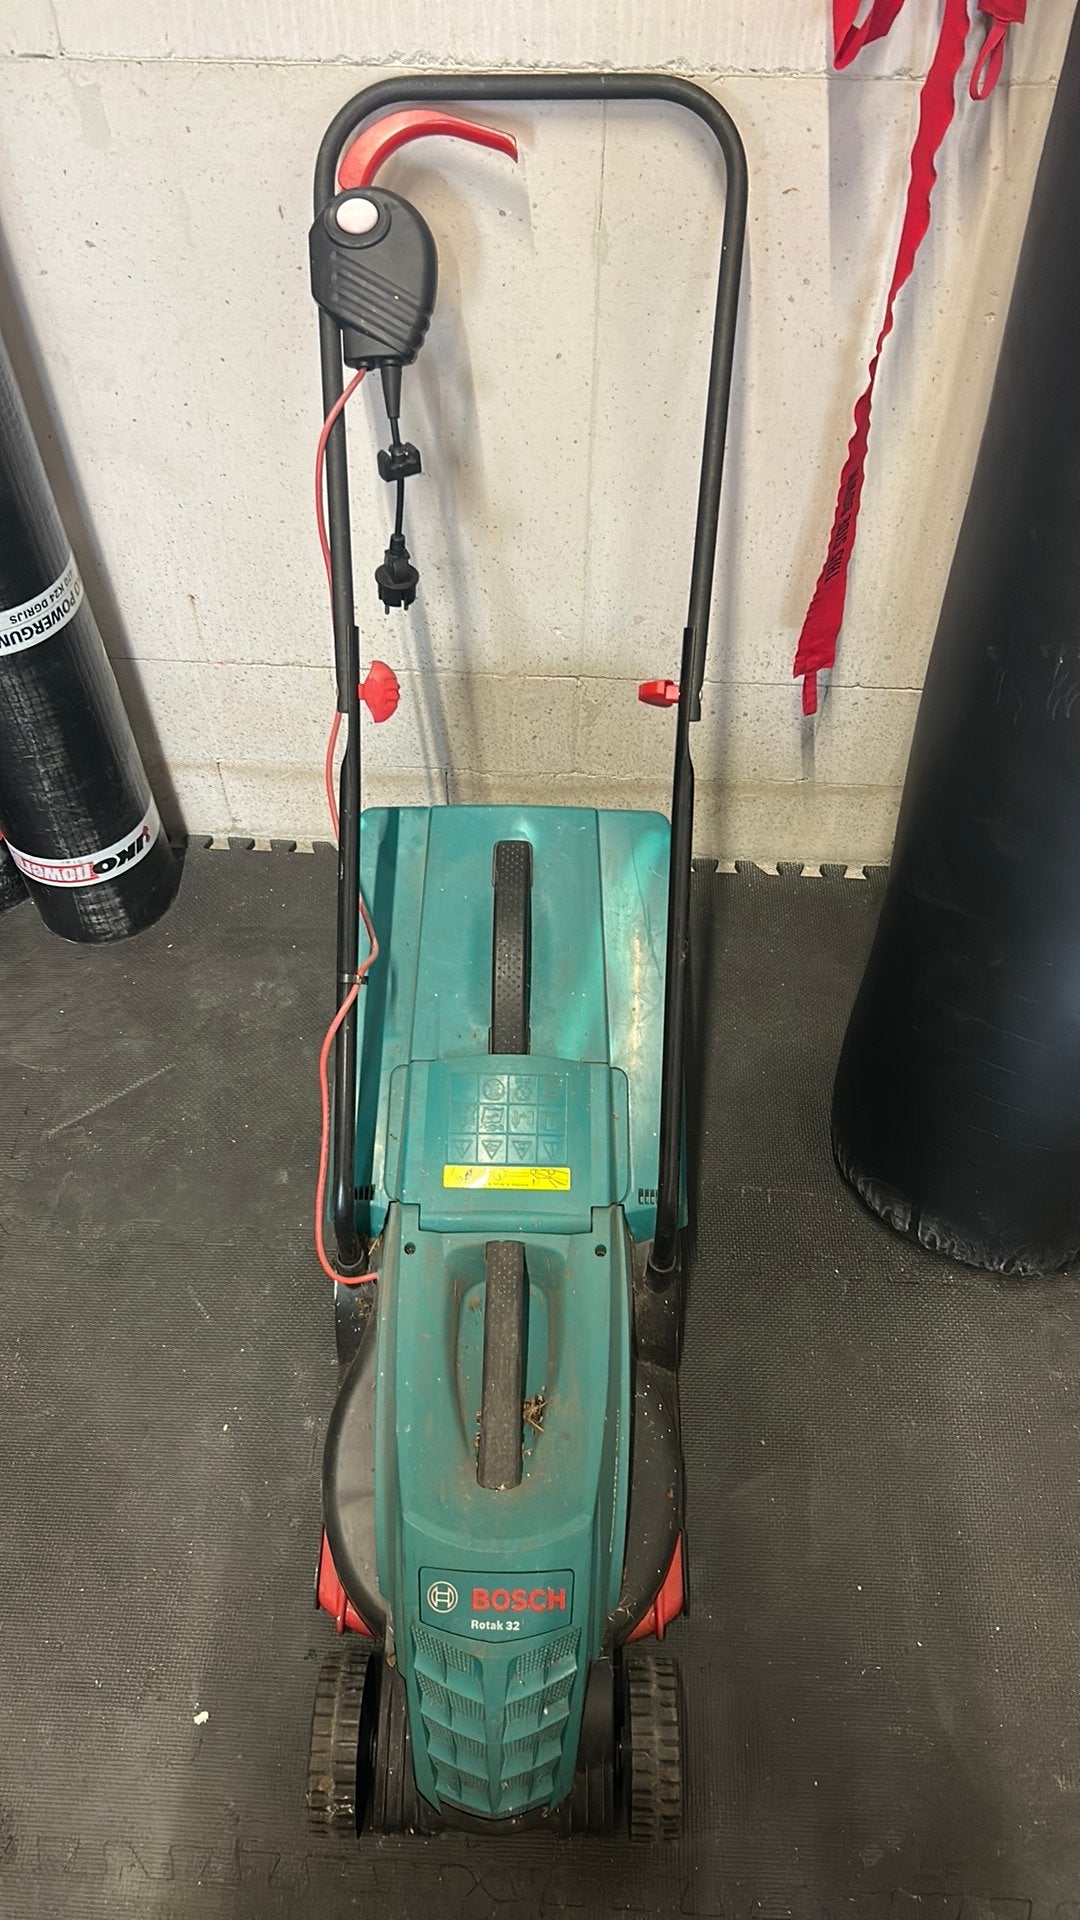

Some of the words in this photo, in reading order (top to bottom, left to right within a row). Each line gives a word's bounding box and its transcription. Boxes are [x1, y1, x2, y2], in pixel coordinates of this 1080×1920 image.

[9, 598, 49, 625] DGRIJS
[471, 1586, 567, 1613] BOSCH
[470, 1619, 504, 1631] Rotak
[505, 1620, 520, 1631] 32
